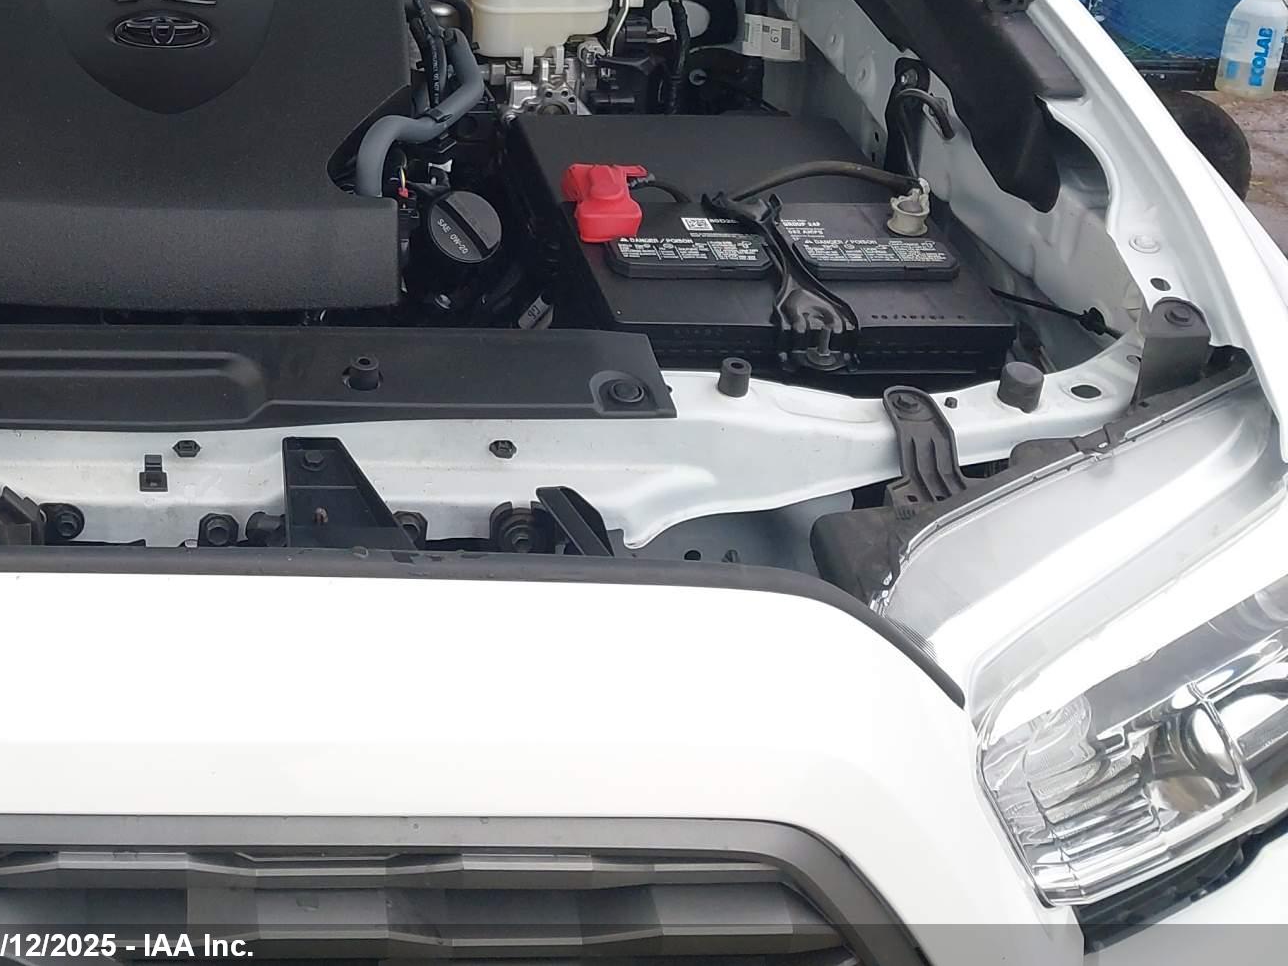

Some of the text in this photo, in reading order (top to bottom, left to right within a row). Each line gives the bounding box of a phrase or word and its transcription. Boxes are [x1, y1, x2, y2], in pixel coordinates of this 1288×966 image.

[1248, 27, 1273, 87] ECOLAB
[437, 218, 469, 255] SAE 0W-20
